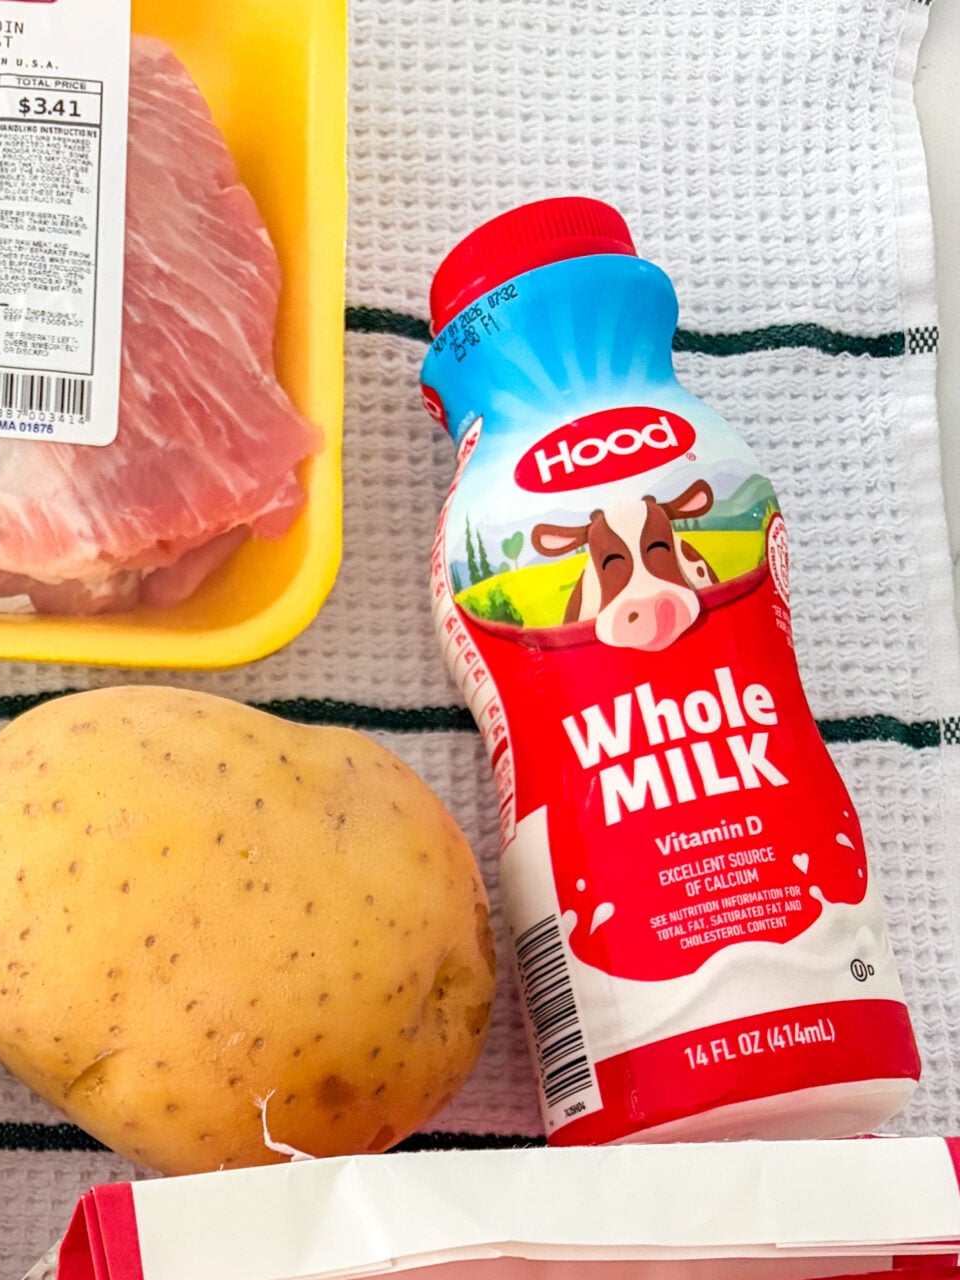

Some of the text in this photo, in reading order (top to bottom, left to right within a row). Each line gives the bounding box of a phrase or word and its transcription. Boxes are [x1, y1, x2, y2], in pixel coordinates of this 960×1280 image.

[16, 58, 59, 69] U.S.A.
[17, 78, 86, 90] TOTAL PRICE
[19, 98, 81, 117] $3.41
[19, 421, 53, 434] 01876
[534, 416, 678, 484] Hood
[562, 667, 778, 769] Whole
[599, 732, 789, 826] MILK
[655, 816, 763, 855] Vitamin D
[658, 847, 775, 886] EXCELLENT SOURCE
[686, 869, 759, 897] OF CALCIUM
[650, 886, 801, 929] SEE NUTRITION INFORMATION FOR
[656, 926, 686, 941] TOTAL
[710, 905, 764, 927] SATURATED
[766, 903, 782, 915] FAT
[784, 900, 802, 912] AND
[680, 916, 787, 949] CHOLESTEROL CONTENT
[684, 1019, 835, 1070] 14 FL OZ (414mL)
